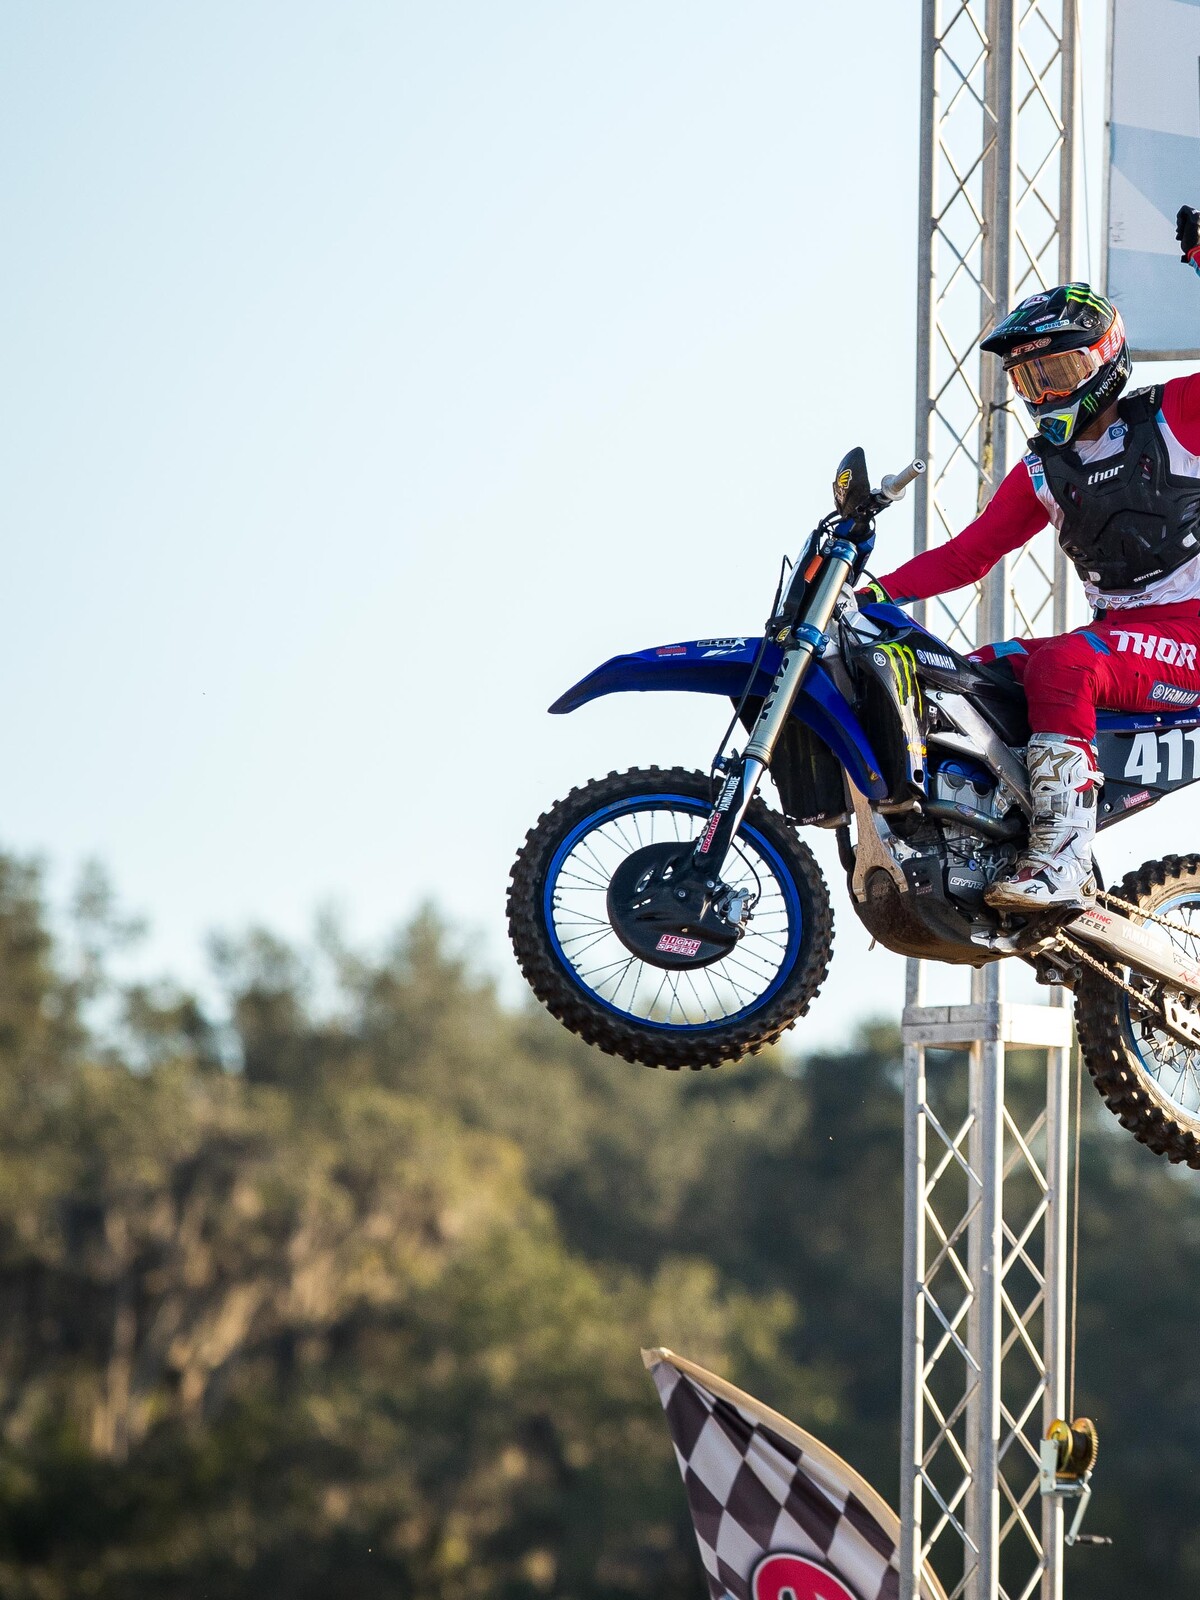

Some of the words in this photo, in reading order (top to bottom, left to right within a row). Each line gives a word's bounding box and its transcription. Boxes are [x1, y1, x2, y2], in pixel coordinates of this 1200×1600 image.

[1087, 464, 1125, 486] thor
[1133, 568, 1164, 583] SENTINEL
[1109, 630, 1198, 671] THOR
[925, 653, 957, 671] YAMAHA
[1162, 685, 1200, 705] YAMAHA
[718, 776, 741, 811] YAMALUBE
[802, 815, 817, 824] Twin
[817, 812, 825, 820] Air
[702, 813, 721, 853] BRAKING
[950, 876, 984, 890] GYTR
[1079, 916, 1108, 934] XCEL
[1084, 910, 1112, 925] AKING
[661, 935, 700, 949] LIGHT
[1121, 924, 1165, 953] YAMALU
[657, 943, 697, 956] SPEED
